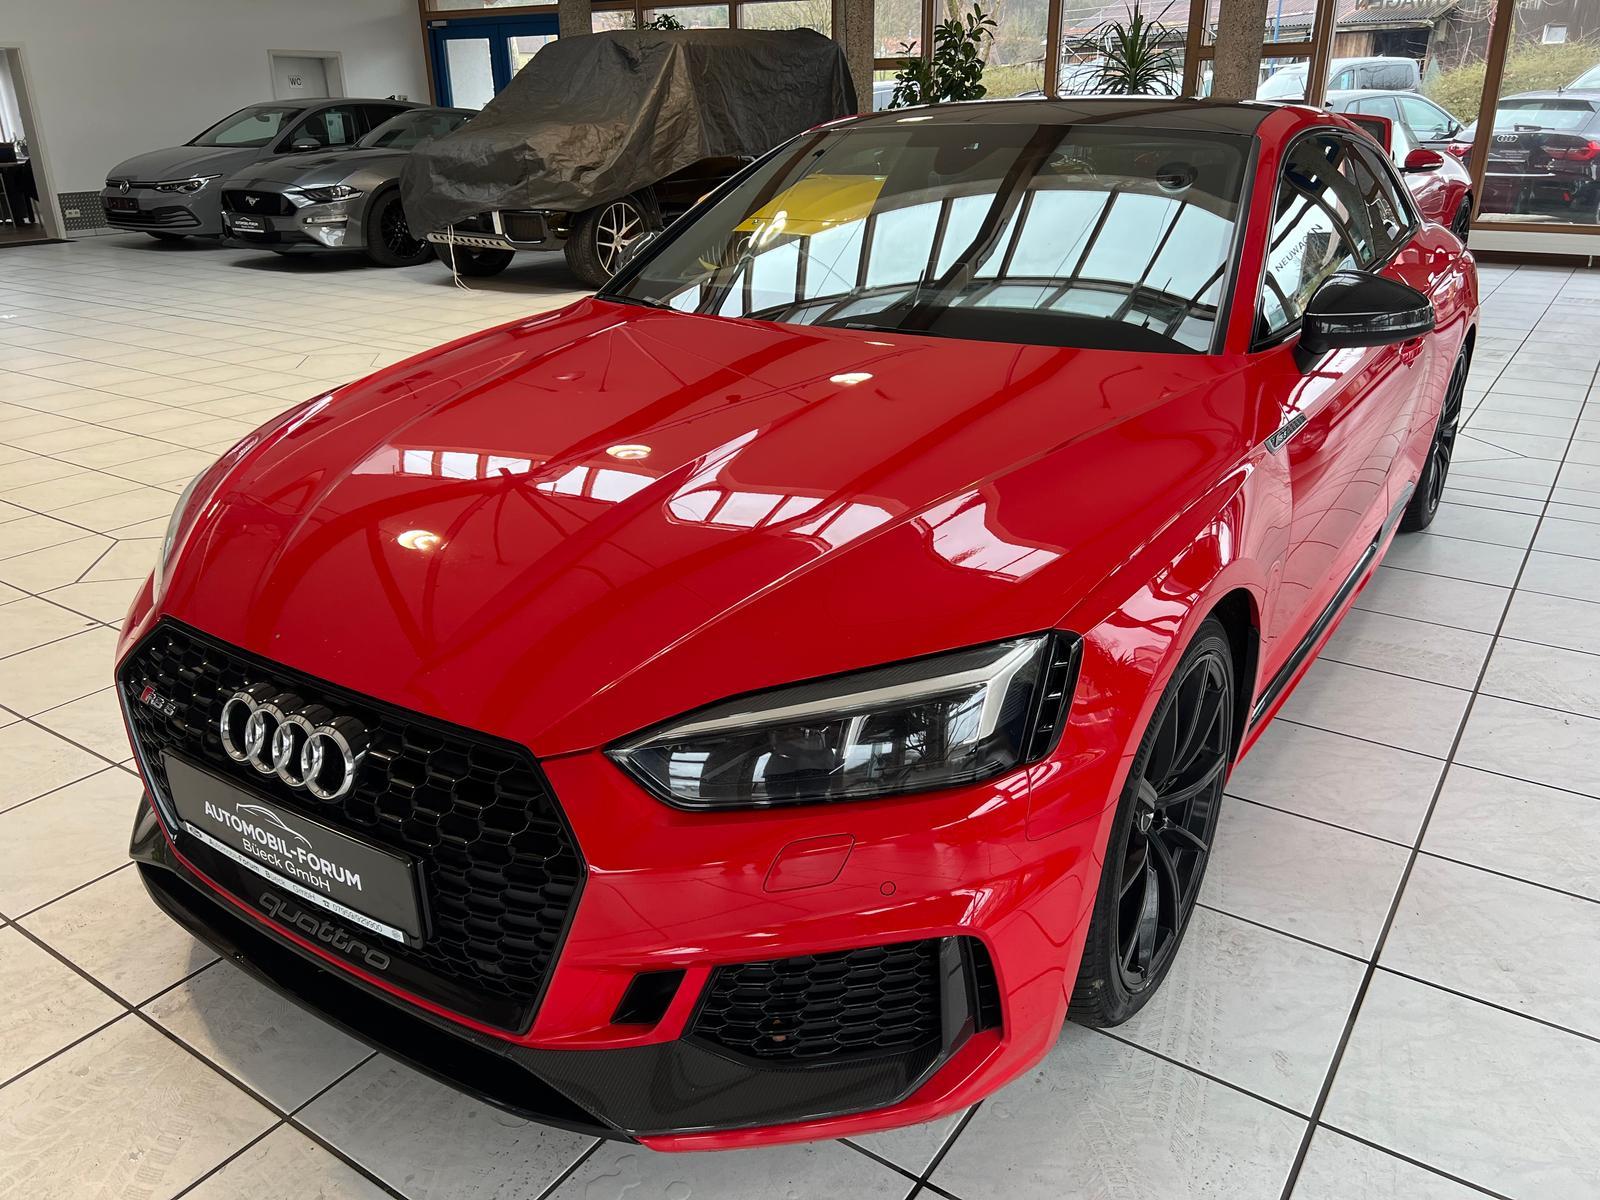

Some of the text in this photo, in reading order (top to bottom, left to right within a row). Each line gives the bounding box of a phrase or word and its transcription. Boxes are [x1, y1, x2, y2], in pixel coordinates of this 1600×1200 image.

[289, 77, 302, 86] WC
[204, 800, 362, 891] AUTOMOBIL-FORUM
[242, 838, 331, 892] Büeck GmbH
[258, 891, 391, 970] quattro
